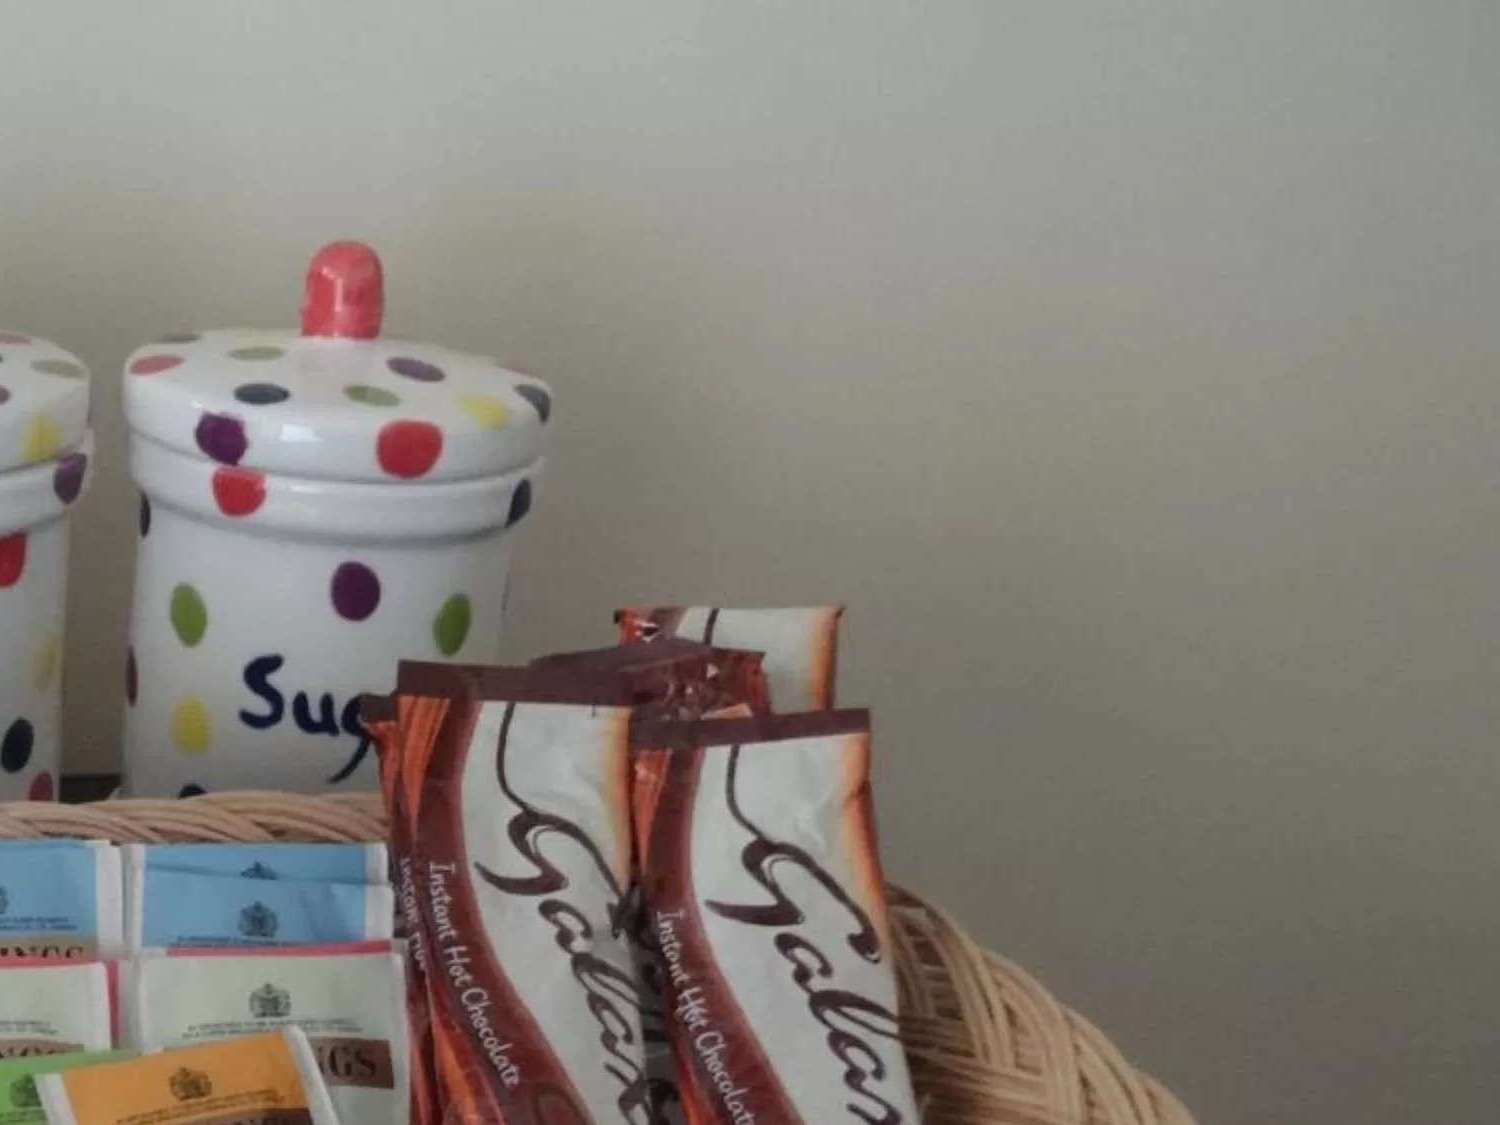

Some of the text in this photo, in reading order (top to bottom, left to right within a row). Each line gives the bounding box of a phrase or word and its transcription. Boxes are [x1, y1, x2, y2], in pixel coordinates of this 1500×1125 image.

[238, 653, 372, 784] Sug
[429, 861, 521, 1089] Instant Hot Chocolate
[657, 908, 691, 988] Instant
[675, 986, 710, 1033] Hot
